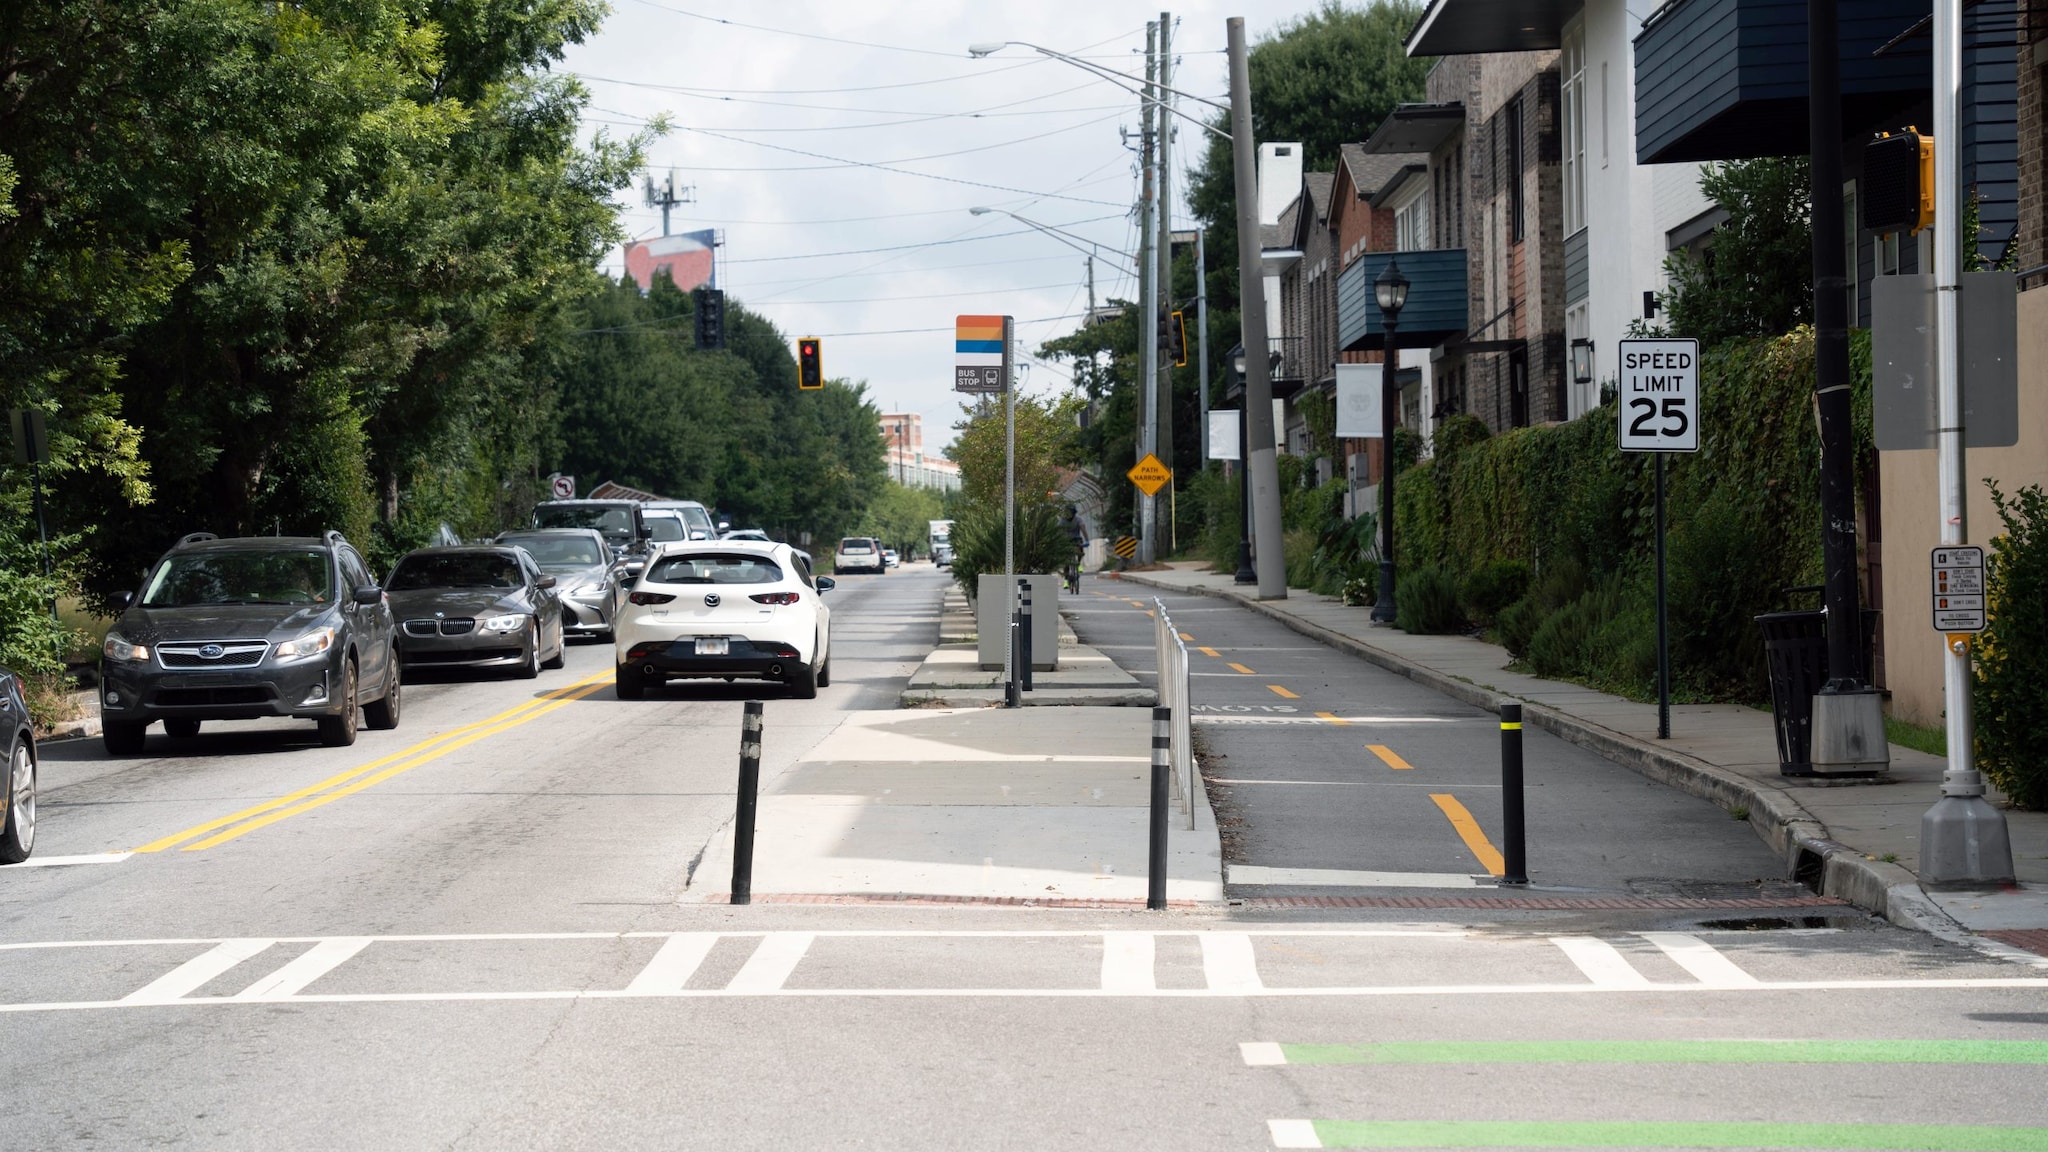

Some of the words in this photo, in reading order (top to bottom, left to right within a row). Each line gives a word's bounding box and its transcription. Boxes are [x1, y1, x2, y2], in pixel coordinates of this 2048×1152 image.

[1626, 353, 1691, 369] SPEED
[958, 369, 976, 377] BUS
[958, 378, 980, 386] STOP
[1633, 375, 1684, 392] LIMIT
[1629, 397, 1688, 438] 25
